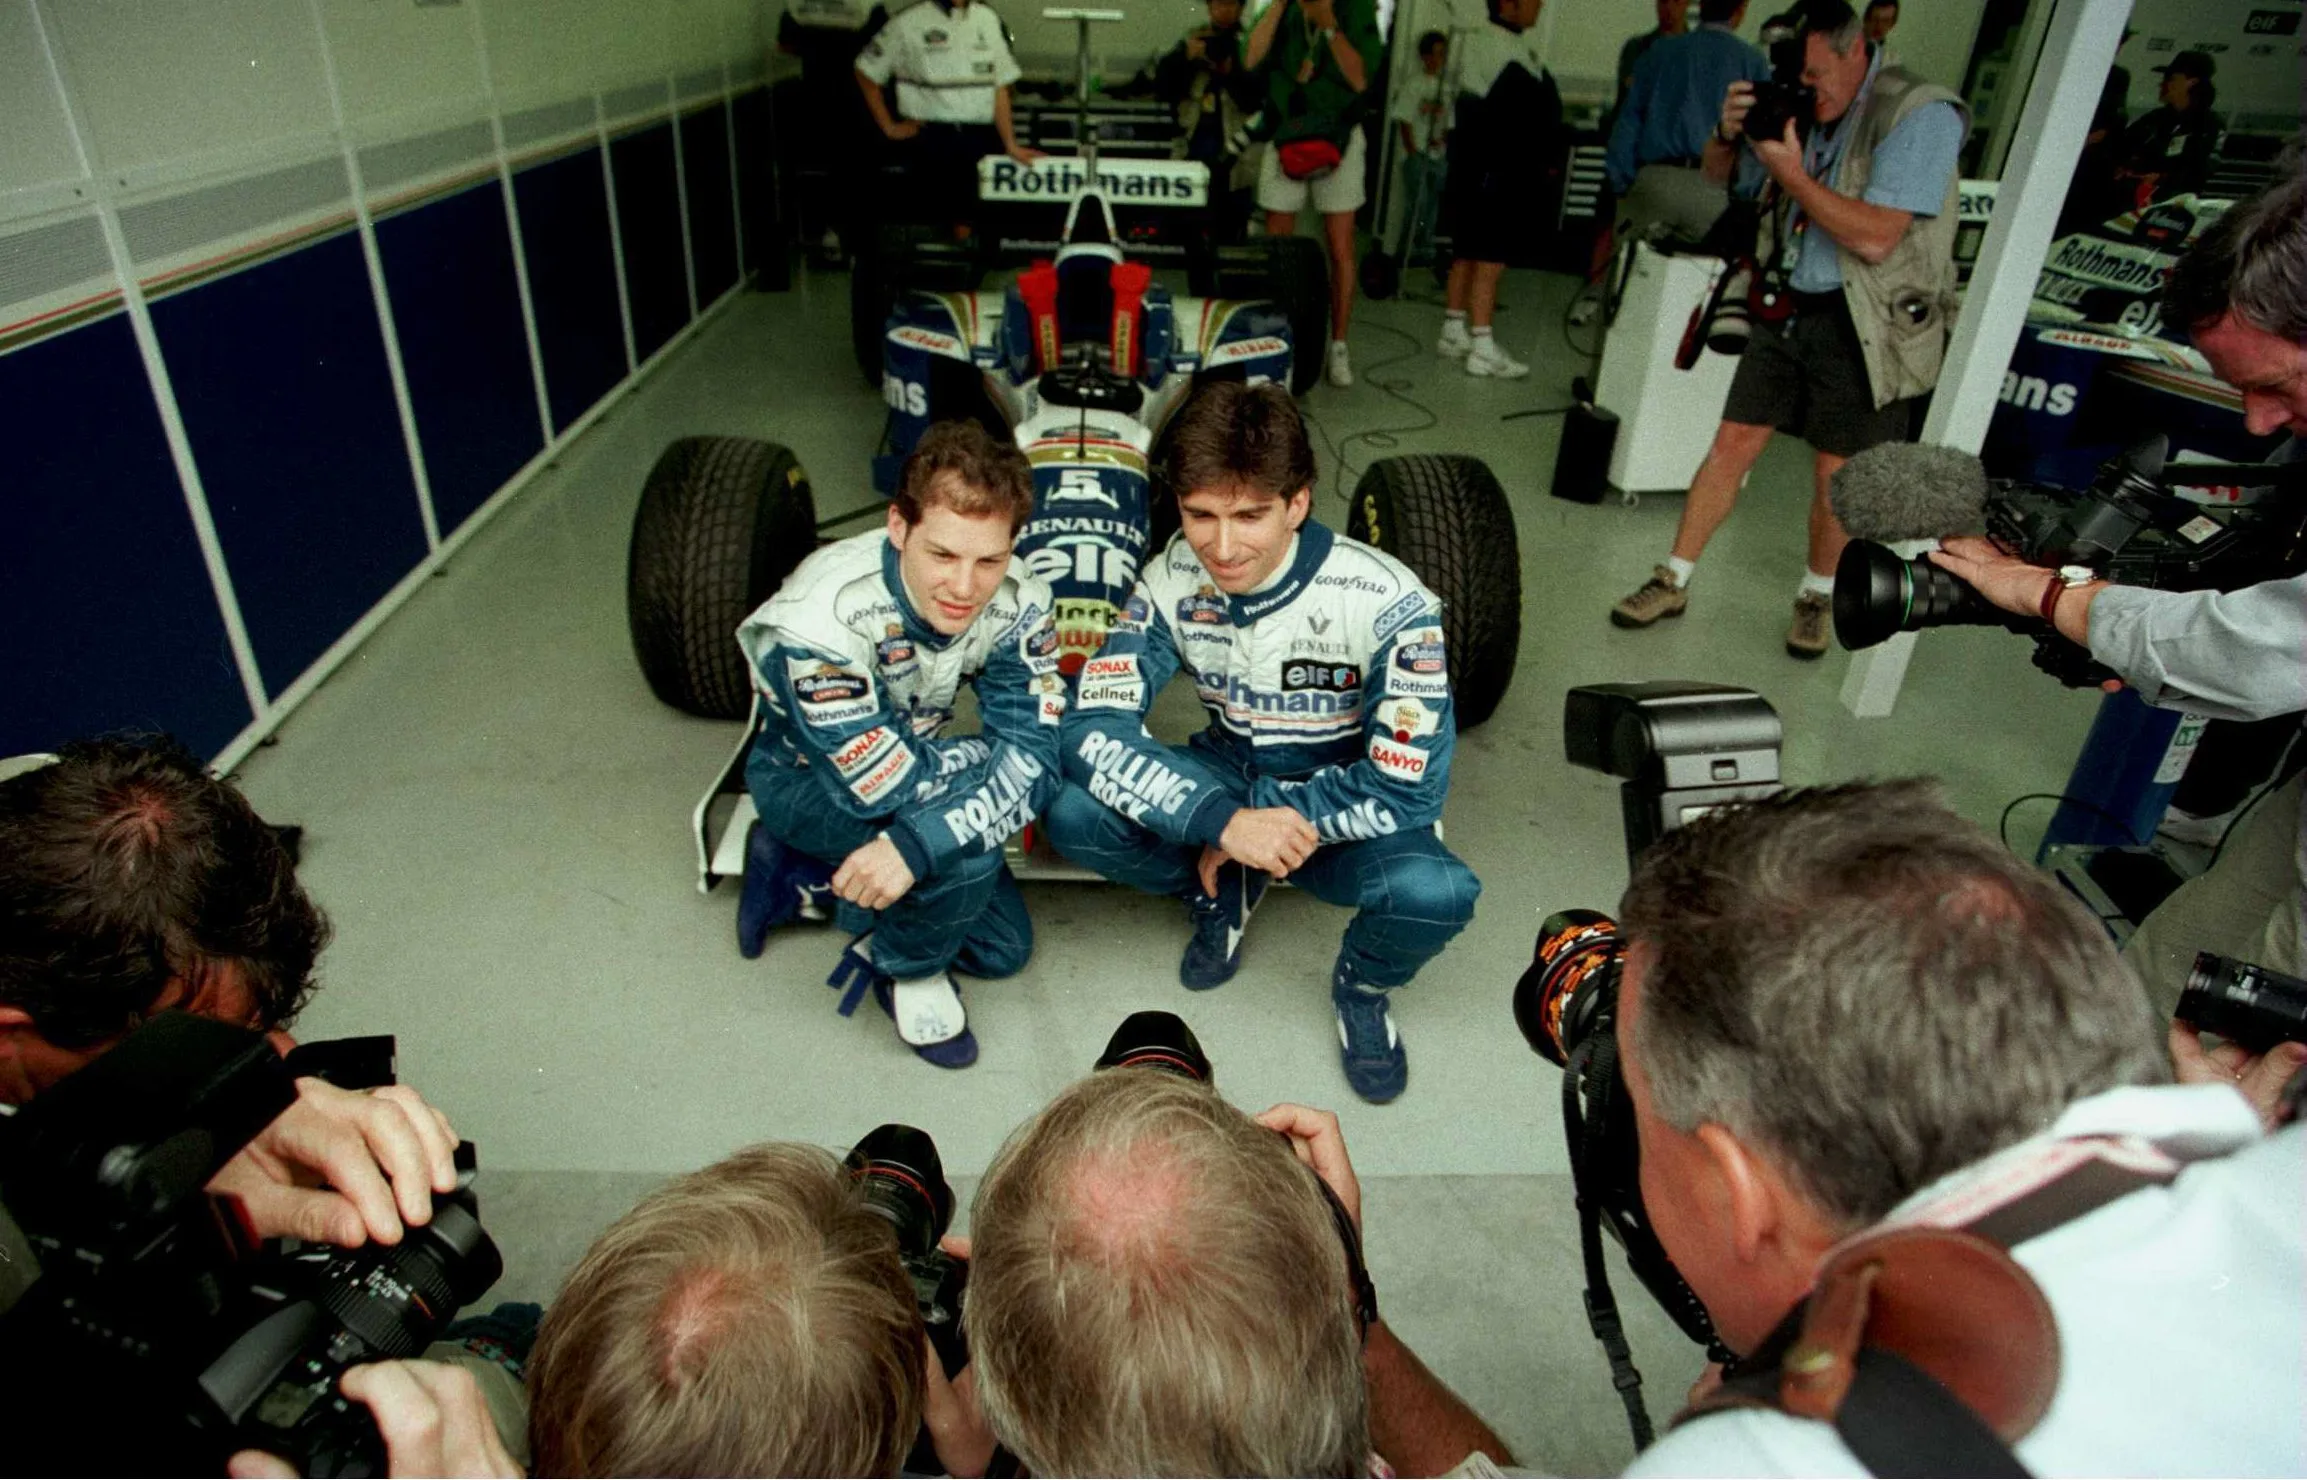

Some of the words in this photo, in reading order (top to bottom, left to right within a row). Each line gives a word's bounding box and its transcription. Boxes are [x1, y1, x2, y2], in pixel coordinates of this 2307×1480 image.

[992, 162, 1193, 198] Rothmans
[2055, 237, 2166, 289] Rothmans
[1024, 543, 1137, 588] elf
[1086, 660, 1131, 674] SONAX
[1286, 665, 1330, 687] elf
[836, 724, 883, 766] SONAX
[1371, 745, 1424, 773] SANYO
[944, 744, 1042, 846] ROLLING
[1078, 730, 1197, 815] ROLLING
[982, 790, 1037, 853] ROCK
[1089, 772, 1155, 826] ROCK
